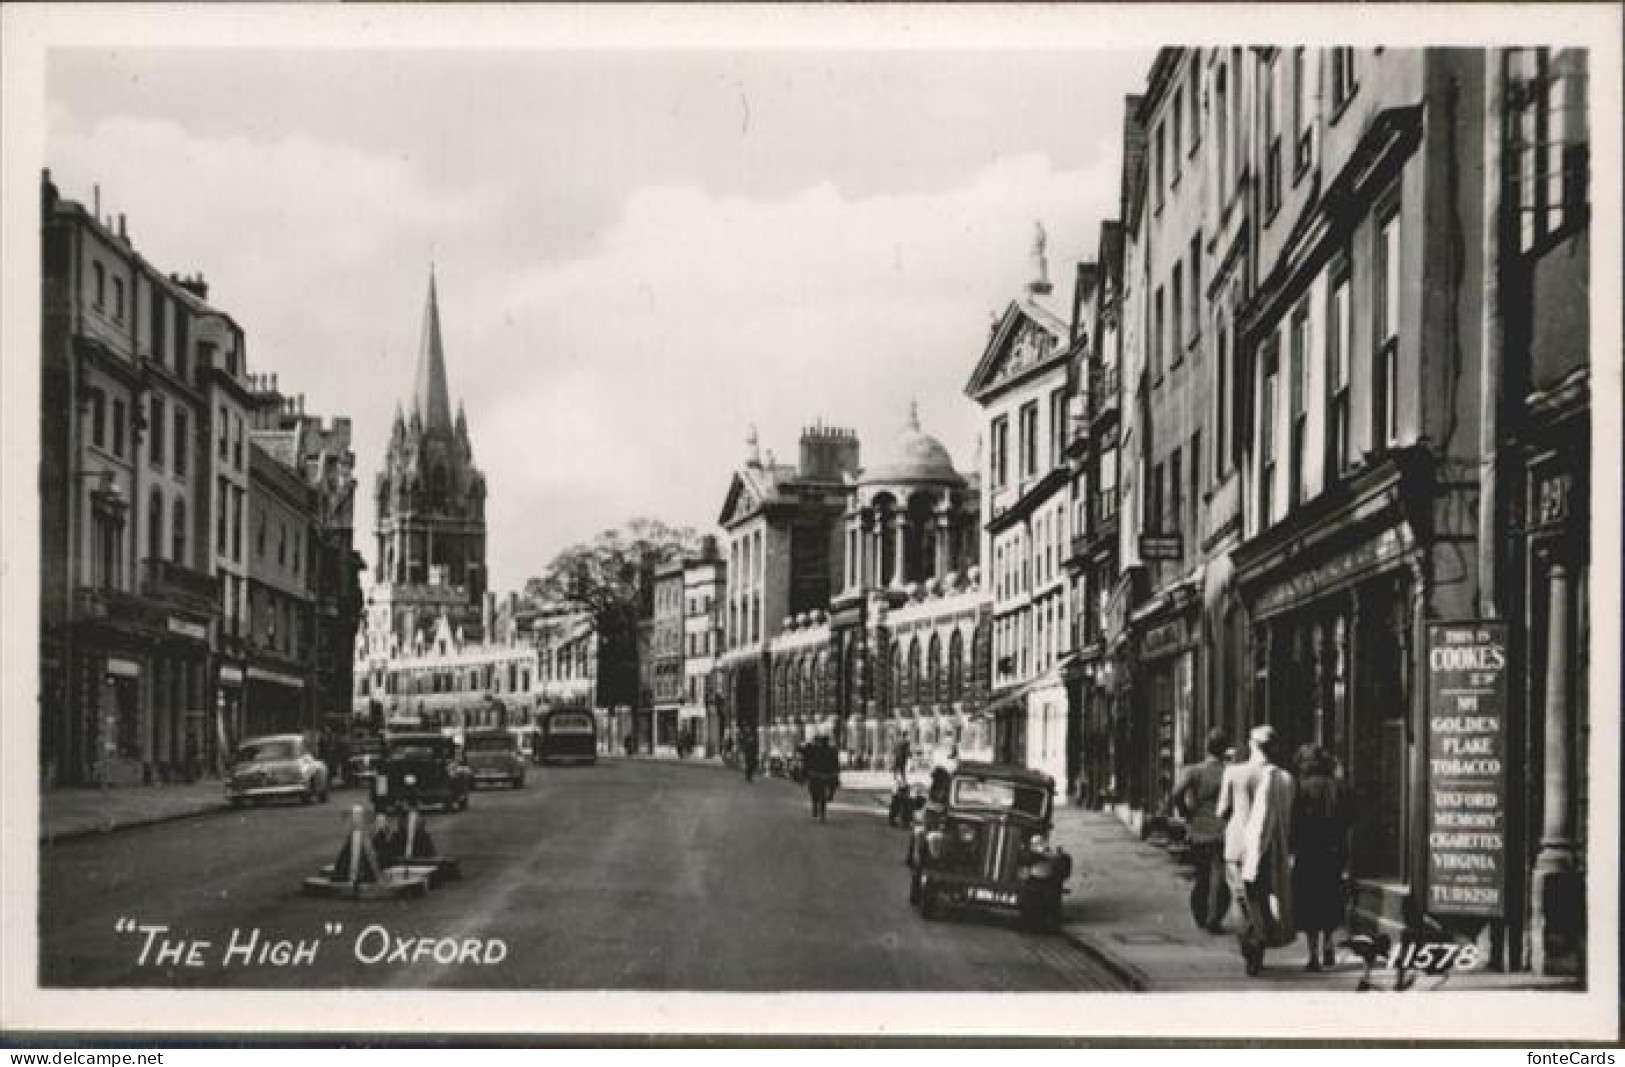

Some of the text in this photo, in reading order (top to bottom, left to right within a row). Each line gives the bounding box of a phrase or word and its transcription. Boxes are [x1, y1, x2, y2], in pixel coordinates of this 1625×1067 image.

[1431, 716, 1500, 733] GOLDEN
[1443, 737, 1493, 755] FLAKE
[1431, 758, 1502, 776] TOBACCO
[1432, 853, 1497, 870] VIRGINIA
[1431, 885, 1499, 905] TURKISH
